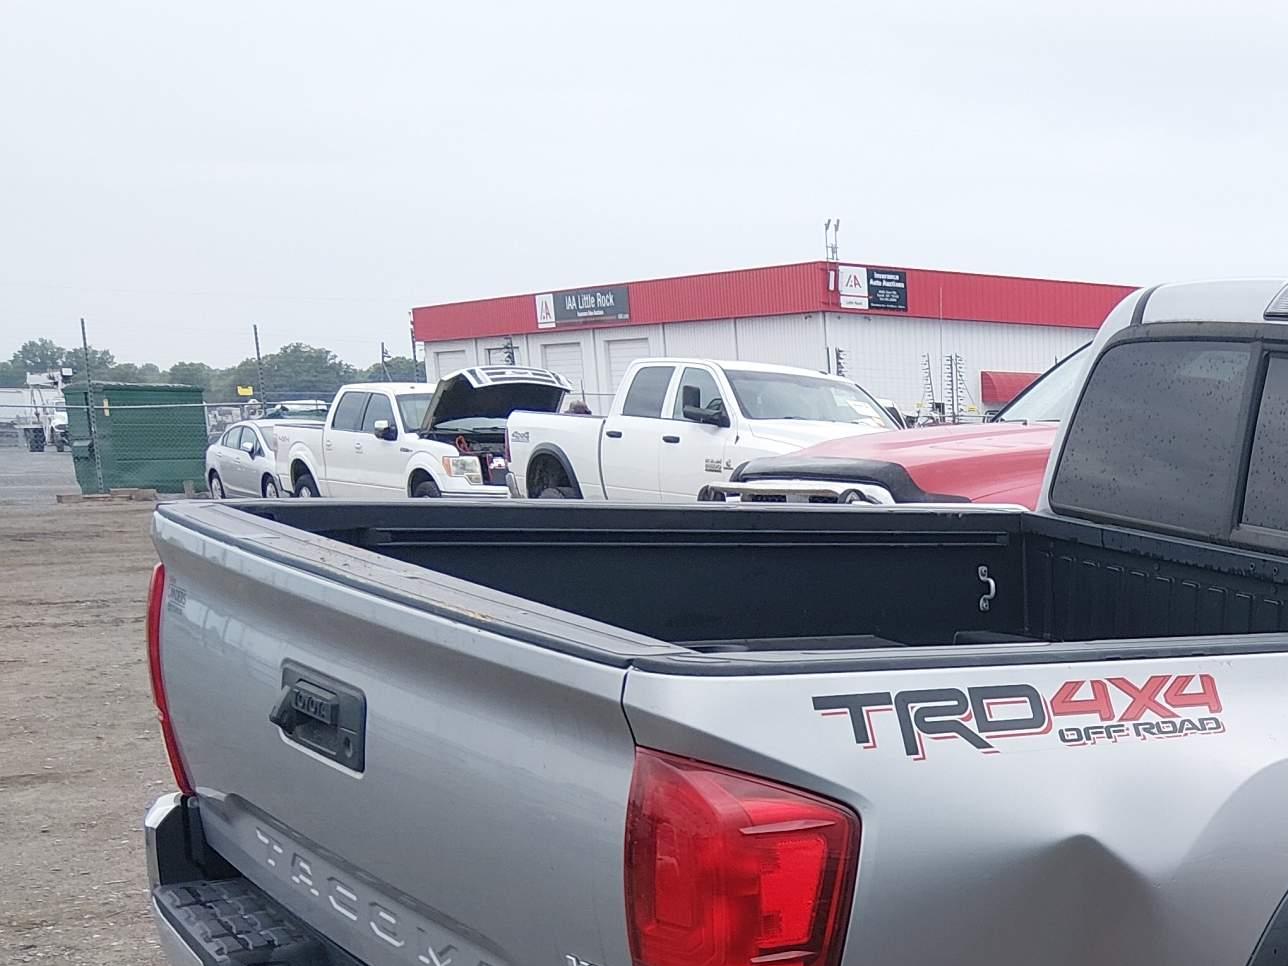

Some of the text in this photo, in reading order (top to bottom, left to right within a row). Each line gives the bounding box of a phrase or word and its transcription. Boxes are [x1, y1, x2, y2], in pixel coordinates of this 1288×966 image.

[565, 290, 615, 310] IAA Little Rock
[812, 684, 1053, 761] TRD
[1058, 717, 1225, 747] OFF ROAD
